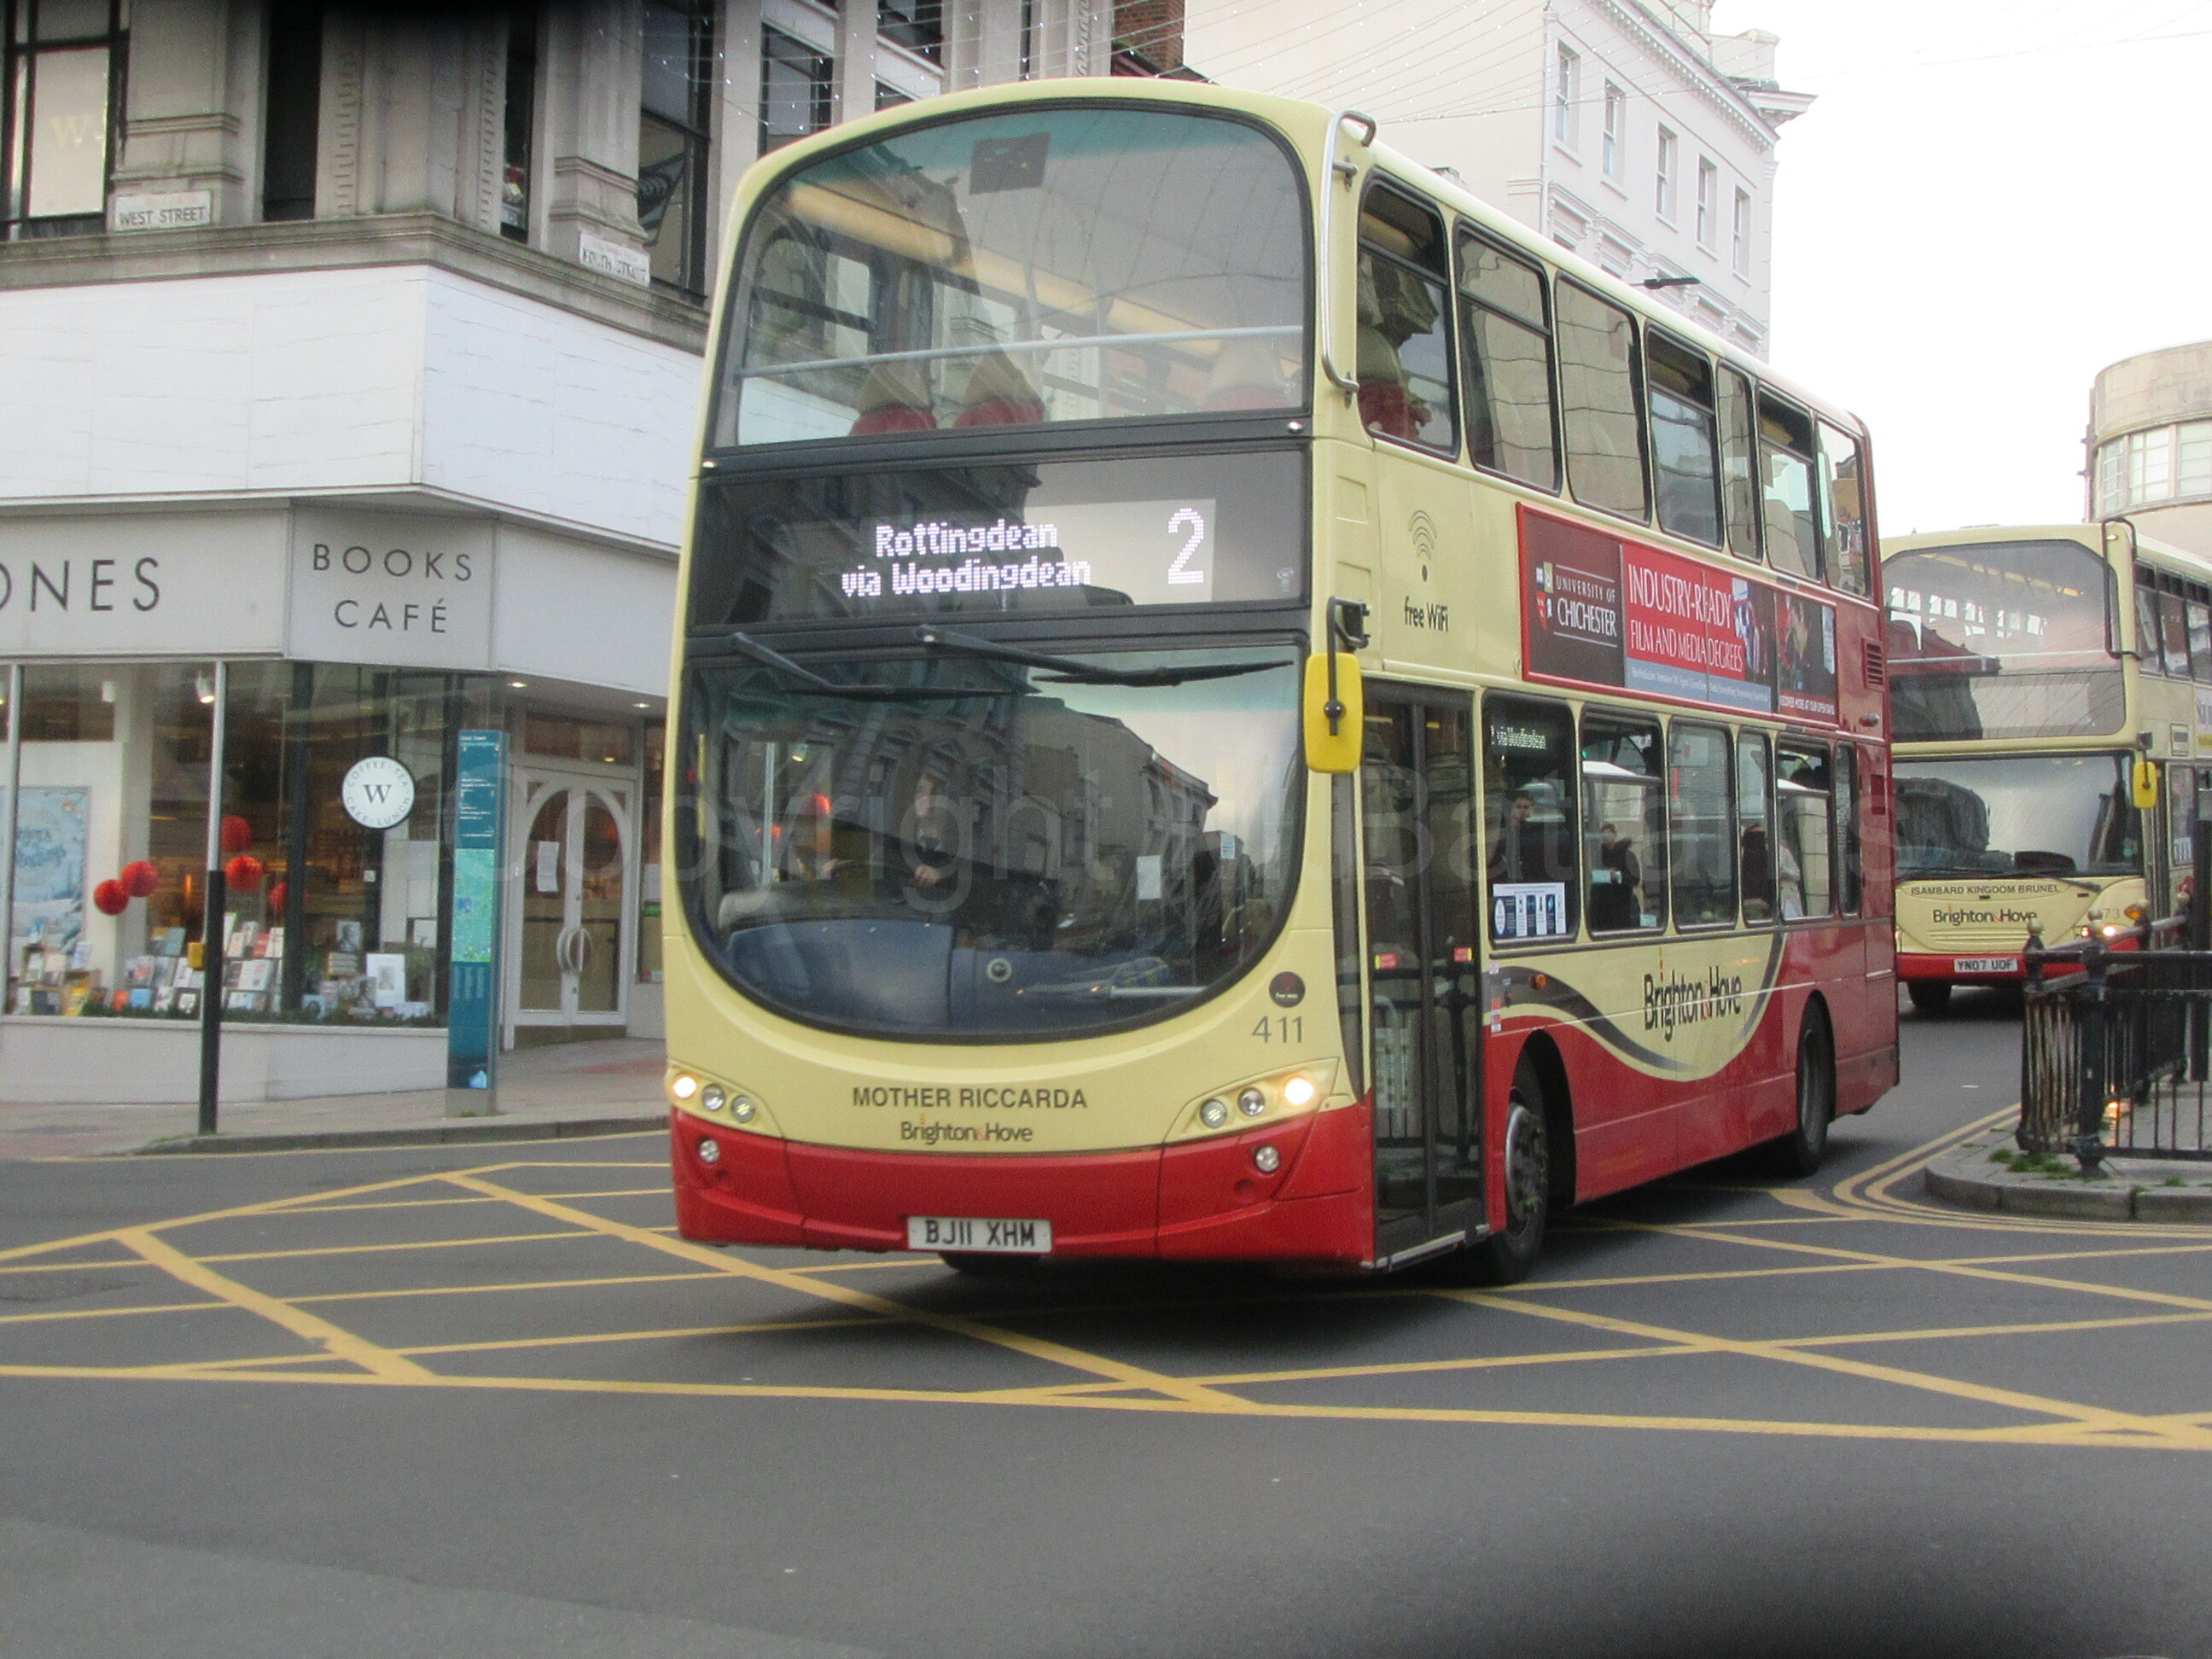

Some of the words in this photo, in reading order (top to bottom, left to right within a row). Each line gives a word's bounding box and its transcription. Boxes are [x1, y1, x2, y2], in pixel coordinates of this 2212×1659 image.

[119, 210, 154, 225] WEST
[160, 207, 205, 224] STREET
[312, 544, 472, 581] BOOKS
[875, 518, 1057, 558] Rottingdean
[1167, 507, 1205, 585] 2
[0, 556, 160, 613] NES
[841, 564, 882, 597] via
[892, 556, 1092, 595] Woodingdean
[1556, 575, 1604, 600] UNIVERSITY
[1606, 588, 1616, 603] OF
[1628, 563, 1732, 628] INDUSTRY-READY
[334, 599, 446, 633] CAFÉ
[1404, 596, 1424, 629] free
[1426, 602, 1449, 632] WiFi
[1557, 597, 1617, 637] CHICHESTER
[1630, 620, 1654, 653] FILM
[1656, 626, 1676, 657] AND
[1678, 632, 1707, 664] MEDIA
[1708, 638, 1743, 672] DEGREES
[362, 783, 393, 804] W
[1911, 886, 1964, 896] ISAMBARD
[1966, 885, 2016, 894] KINGDOM
[2018, 884, 2059, 894] BRUNEL
[1956, 960, 1988, 971] YN07
[1252, 1016, 1303, 1044] 411
[853, 1087, 951, 1108] MOTHER
[959, 1088, 1088, 1109] RICCARDA
[925, 1220, 973, 1246] BJ11
[987, 1221, 1036, 1248] XHM
